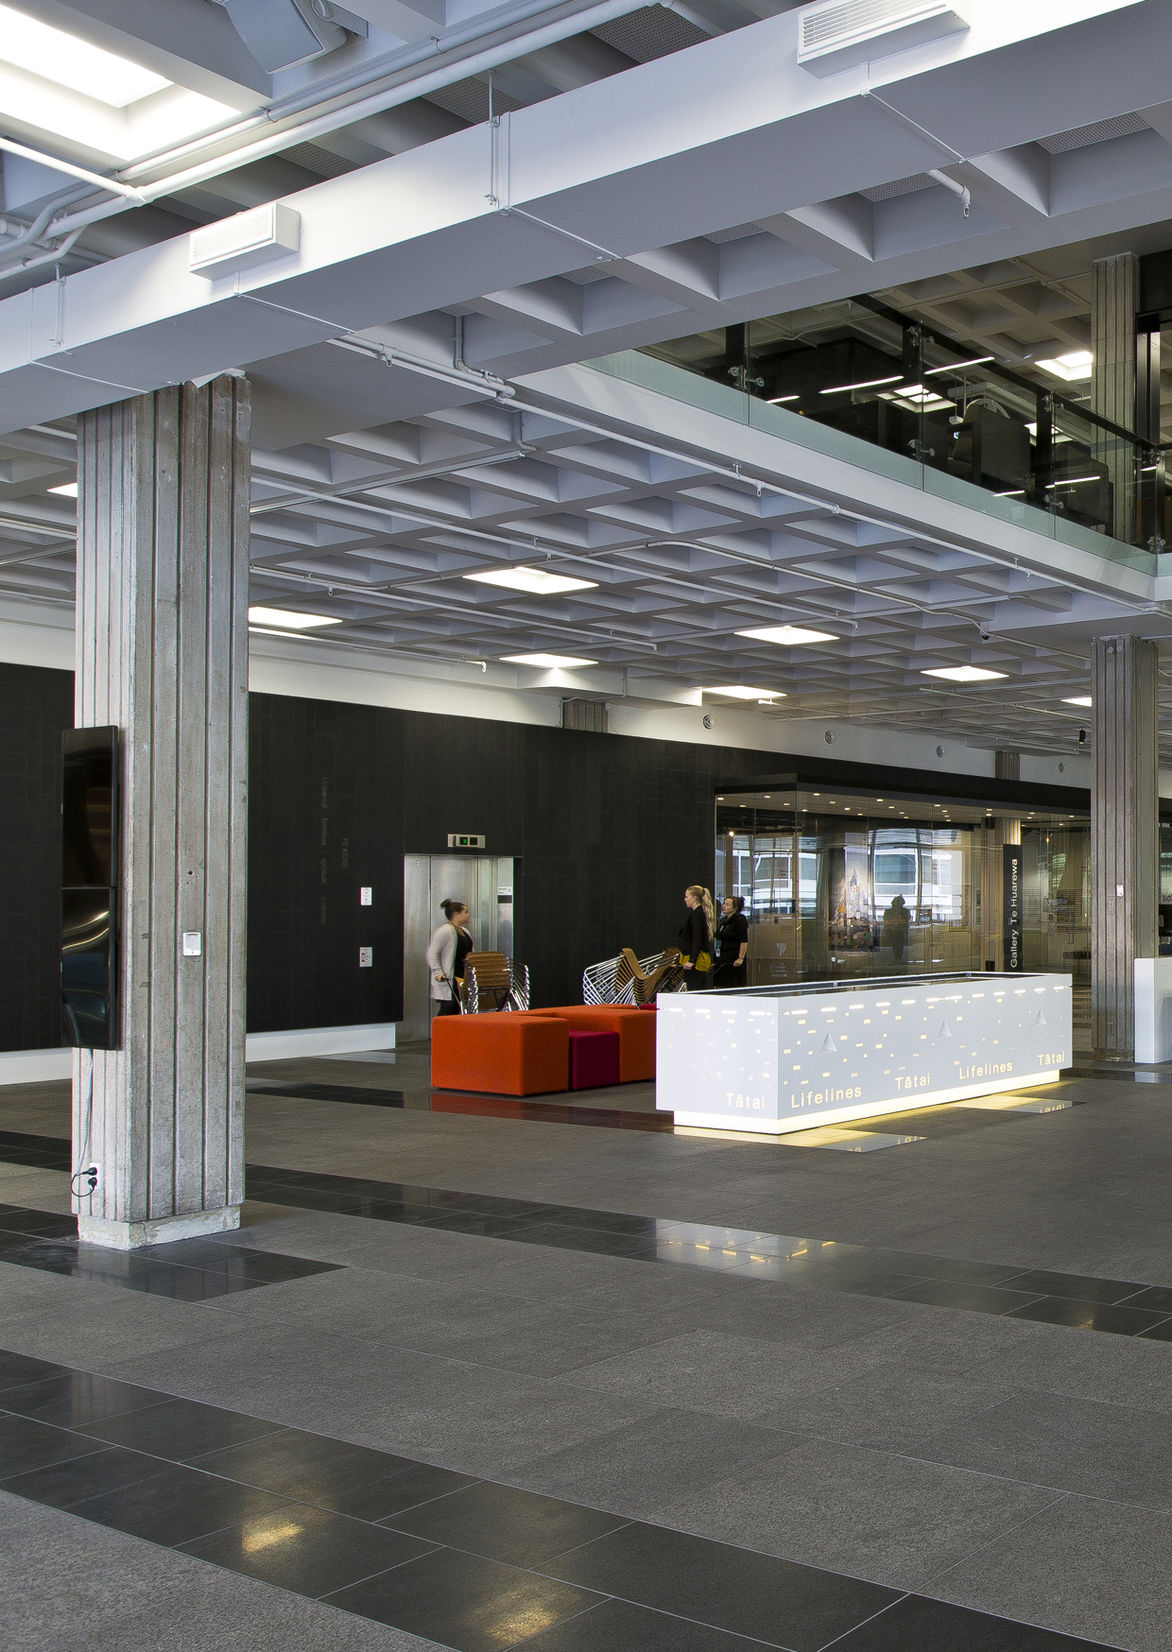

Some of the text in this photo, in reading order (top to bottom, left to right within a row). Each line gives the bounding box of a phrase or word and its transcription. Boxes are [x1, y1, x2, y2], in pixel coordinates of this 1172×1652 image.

[1010, 858, 1019, 968] Gallery Te Huarewa
[791, 1086, 862, 1109] Lifelines
[959, 1061, 1013, 1080] Lifelines
